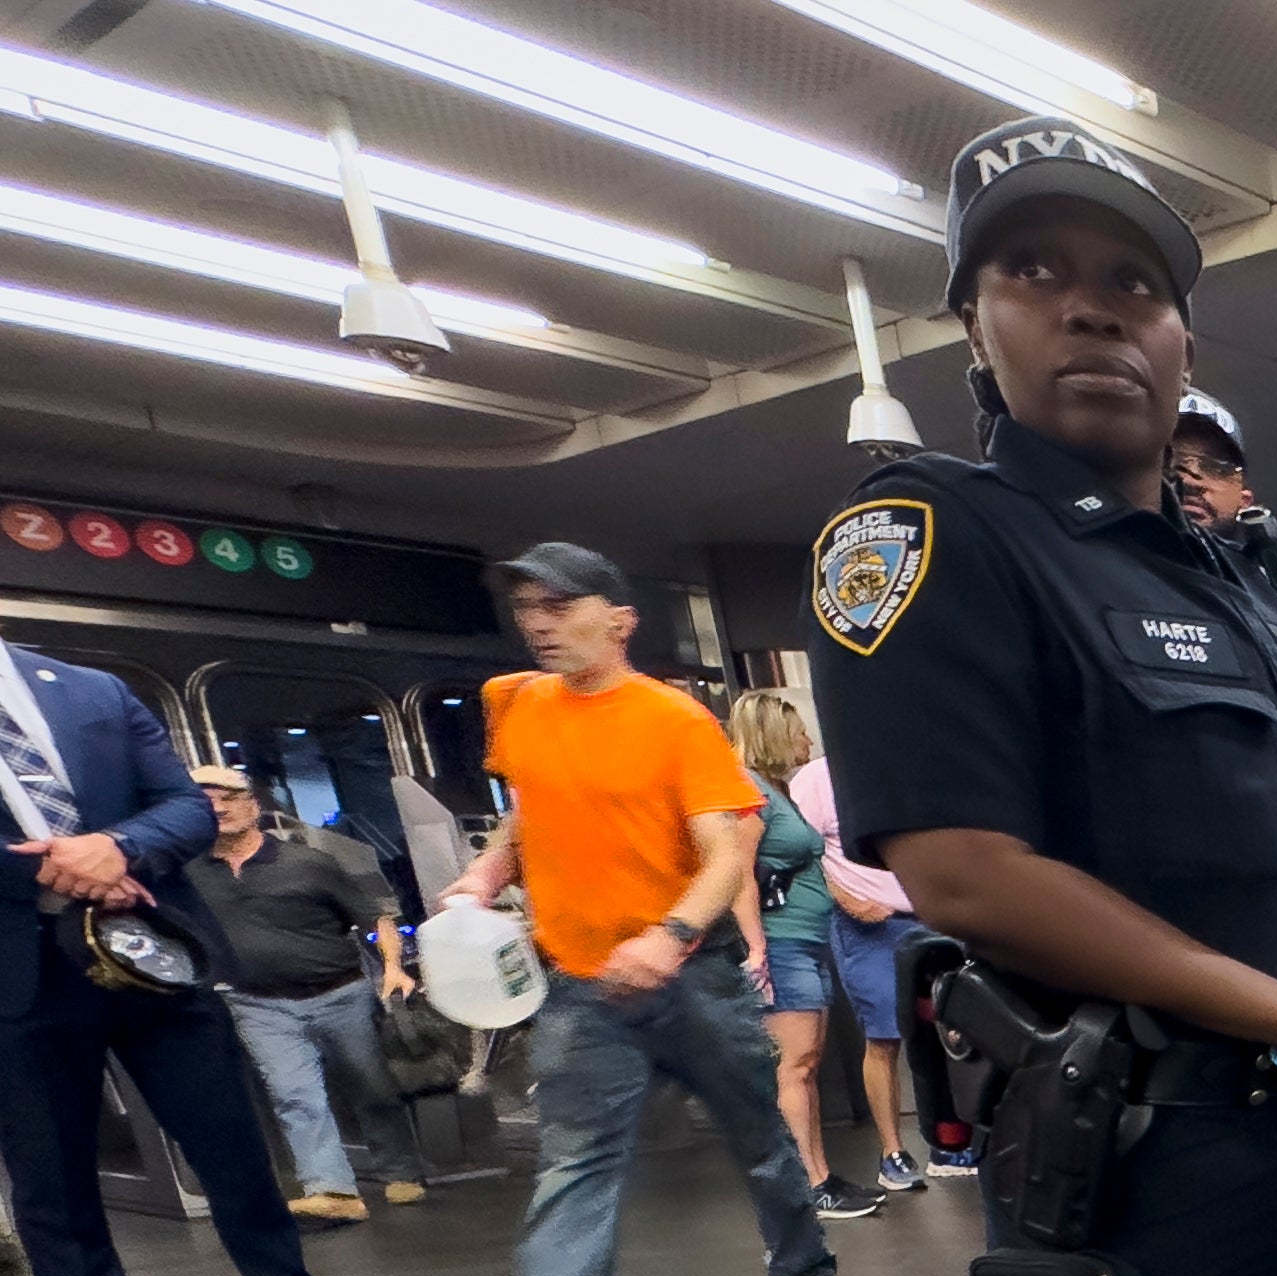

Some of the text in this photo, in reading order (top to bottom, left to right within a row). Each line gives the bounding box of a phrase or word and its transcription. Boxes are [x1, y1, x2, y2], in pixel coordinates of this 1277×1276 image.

[15, 511, 299, 571] Z 2 3 4 5
[820, 524, 918, 573] DEPARTMENT
[834, 510, 892, 542] POLICE
[818, 588, 852, 634] CITY OF
[871, 549, 922, 630] NEW YORK
[1142, 619, 1212, 643] HARTE
